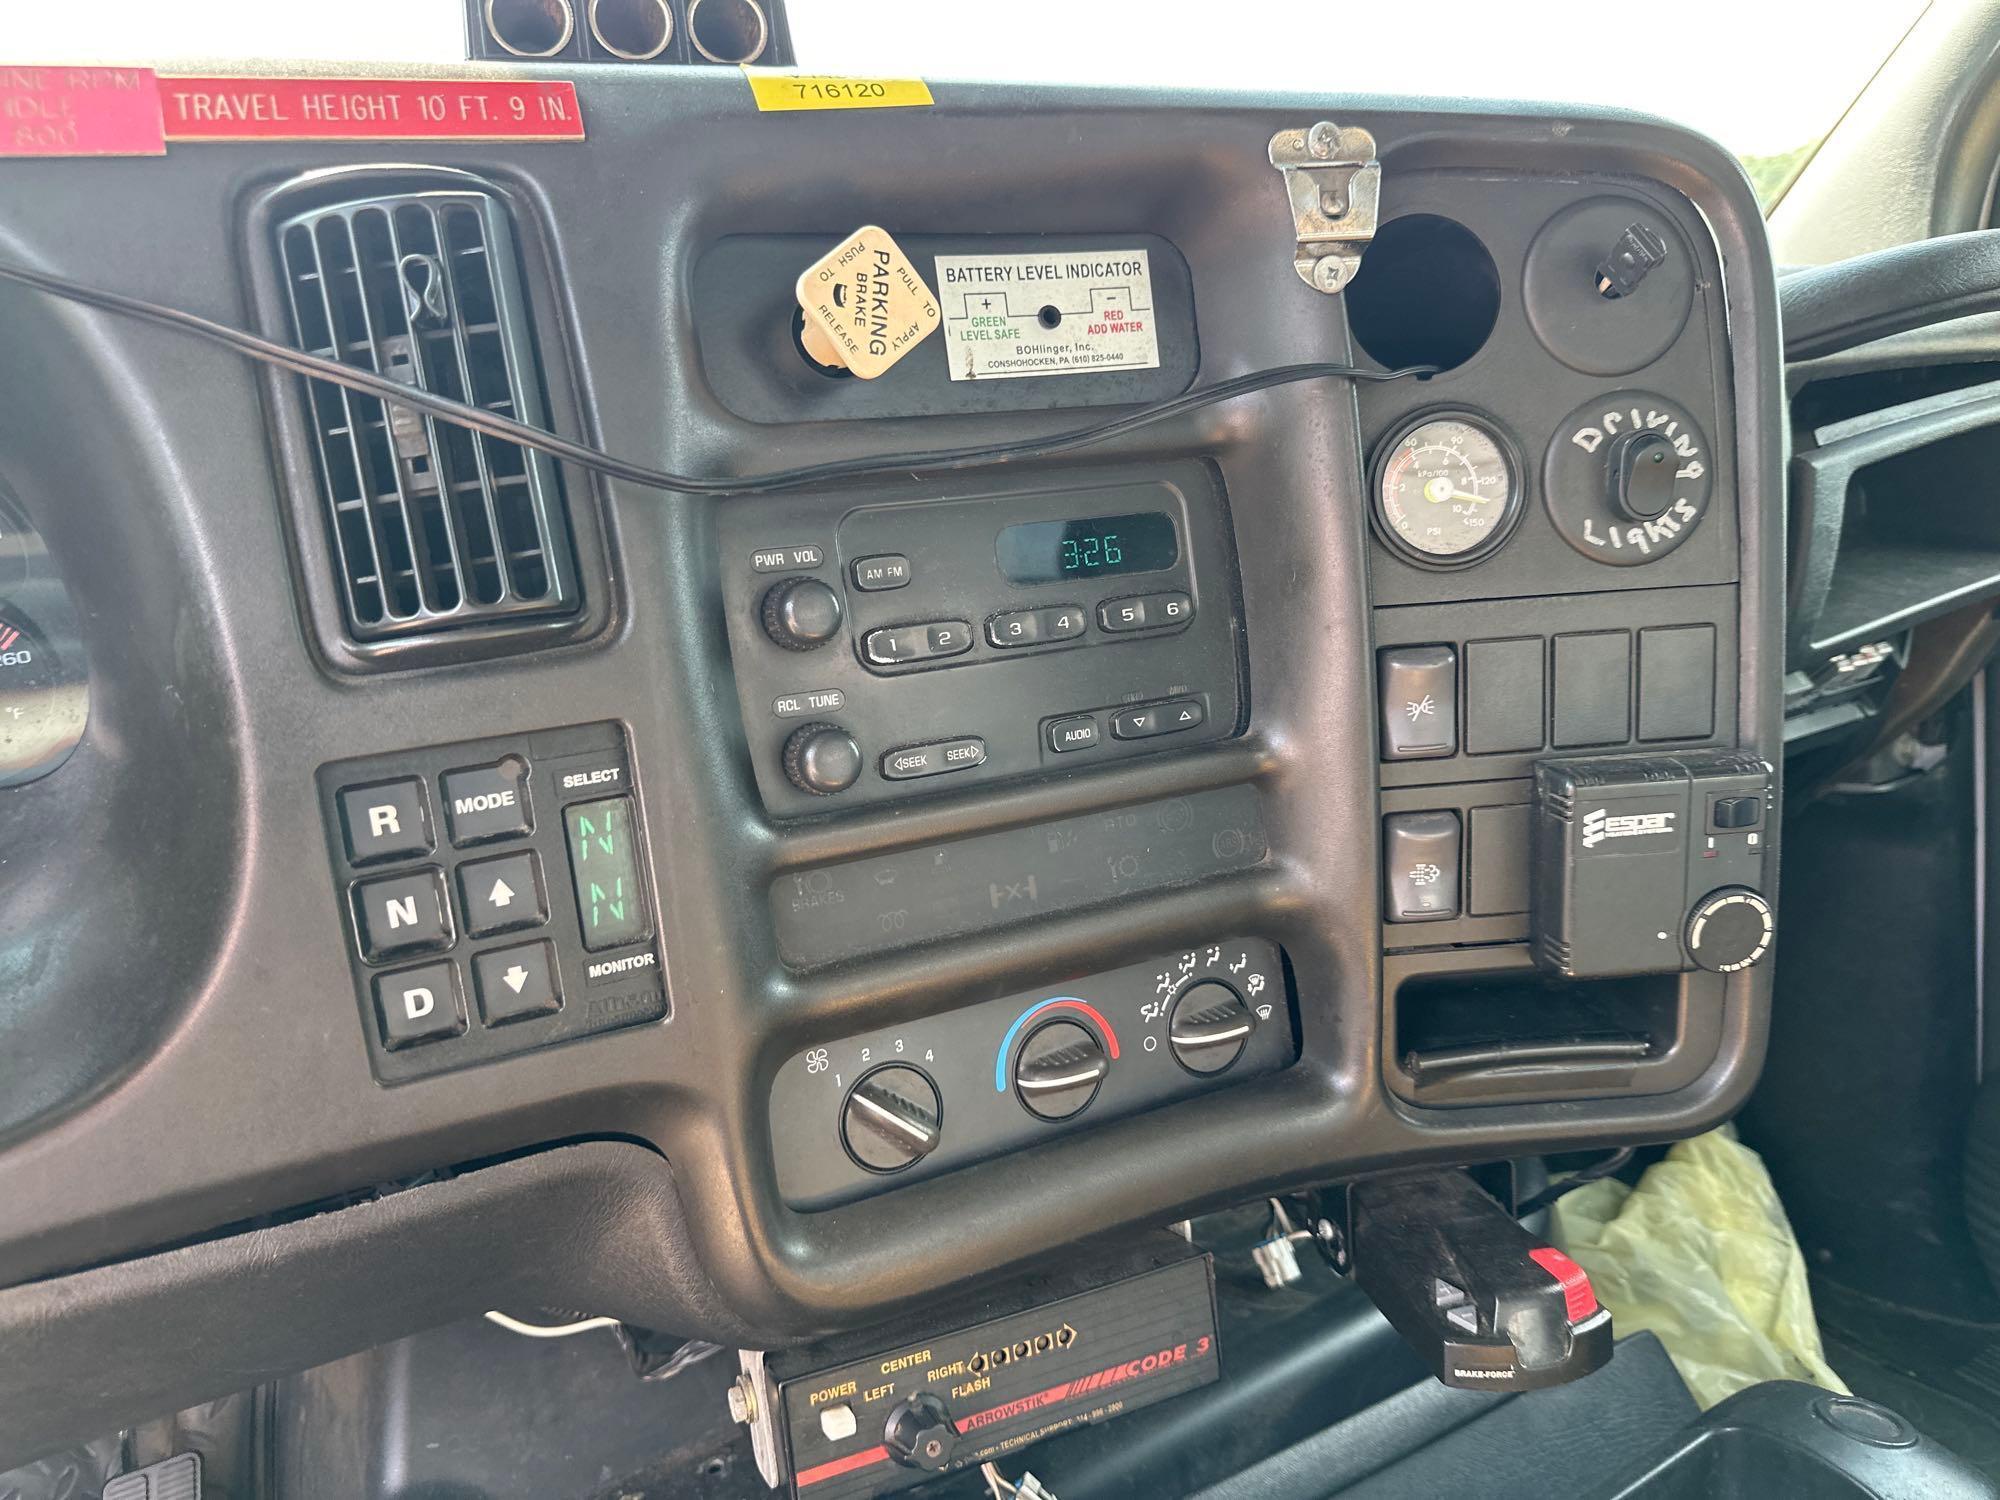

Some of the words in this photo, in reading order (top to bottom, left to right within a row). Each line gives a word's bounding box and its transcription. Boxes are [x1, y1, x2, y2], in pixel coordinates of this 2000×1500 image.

[65, 70, 141, 92] RPM
[793, 83, 885, 99] 716120
[6, 96, 73, 119] IDLE
[173, 93, 289, 121] TRAVEL
[302, 94, 400, 121] HEIGHT
[417, 94, 446, 121] 10
[458, 95, 498, 121] FT.
[509, 96, 525, 121] 9
[539, 96, 572, 121] IN.
[838, 242, 866, 267] PUSH
[819, 268, 835, 282] TO
[897, 267, 919, 296] PULL
[946, 266, 1012, 283] BATTERY
[1017, 265, 1062, 281] LEVEL
[1066, 261, 1142, 279] INDICATOR
[854, 272, 868, 327] BRAKE
[869, 249, 890, 356] PARKING
[922, 300, 936, 317] TO
[971, 316, 1006, 328] GREEN
[1104, 310, 1123, 321] RED
[818, 304, 859, 355] RELEASE
[892, 321, 920, 351] APPLY
[960, 329, 992, 341] LEVEL
[994, 328, 1020, 339] SAFE
[1087, 323, 1108, 335] ADD
[1110, 321, 1143, 333] WATER
[1075, 342, 1094, 352] Inc.
[988, 357, 1057, 369] CONSHOHOCKEN,
[1059, 356, 1070, 365] PA
[1072, 355, 1089, 365] (610)
[1405, 438, 1417, 447] 60
[1451, 436, 1463, 445] 90
[1399, 484, 1406, 492] 2
[1481, 476, 1496, 485] 120
[1452, 505, 1462, 513] 10
[1426, 527, 1441, 536] PSI
[755, 553, 785, 567] PWR
[793, 550, 817, 564] VOL
[1062, 535, 1122, 569] 3:26
[866, 569, 883, 579] AM
[887, 567, 903, 578] FM
[1121, 608, 1134, 622] 5
[1166, 602, 1179, 616] 6
[1009, 622, 1022, 635] 3
[1057, 616, 1069, 629] 4
[889, 638, 897, 651] 1
[938, 631, 951, 645] 2
[0, 650, 32, 666] 60
[778, 700, 801, 712] RCL
[808, 693, 840, 708] TUNE
[1065, 728, 1091, 742] AUDIO
[903, 755, 928, 768] SEEK
[947, 747, 970, 761] SEEK
[563, 767, 620, 788] SELECT
[368, 804, 401, 837] R
[455, 791, 516, 815] MODE
[579, 811, 614, 861] N
[385, 896, 418, 929] N
[591, 877, 625, 928] N
[589, 953, 656, 979] MONITOR
[403, 987, 434, 1020] D
[834, 1073, 841, 1087] 1
[862, 1047, 871, 1061] 2
[895, 1039, 904, 1053] 3
[925, 1049, 935, 1063] 4
[881, 1349, 931, 1375] CENTER
[1126, 1344, 1187, 1376] CODE
[1196, 1336, 1210, 1355] 3
[927, 1360, 964, 1383] RIGHT
[1454, 1368, 1514, 1379] BRAKE-FORCE
[810, 1380, 857, 1406] POWER
[864, 1382, 895, 1402] LEFT
[951, 1376, 991, 1399] FLASH
[1000, 1429, 1040, 1451] TECHNICAL
